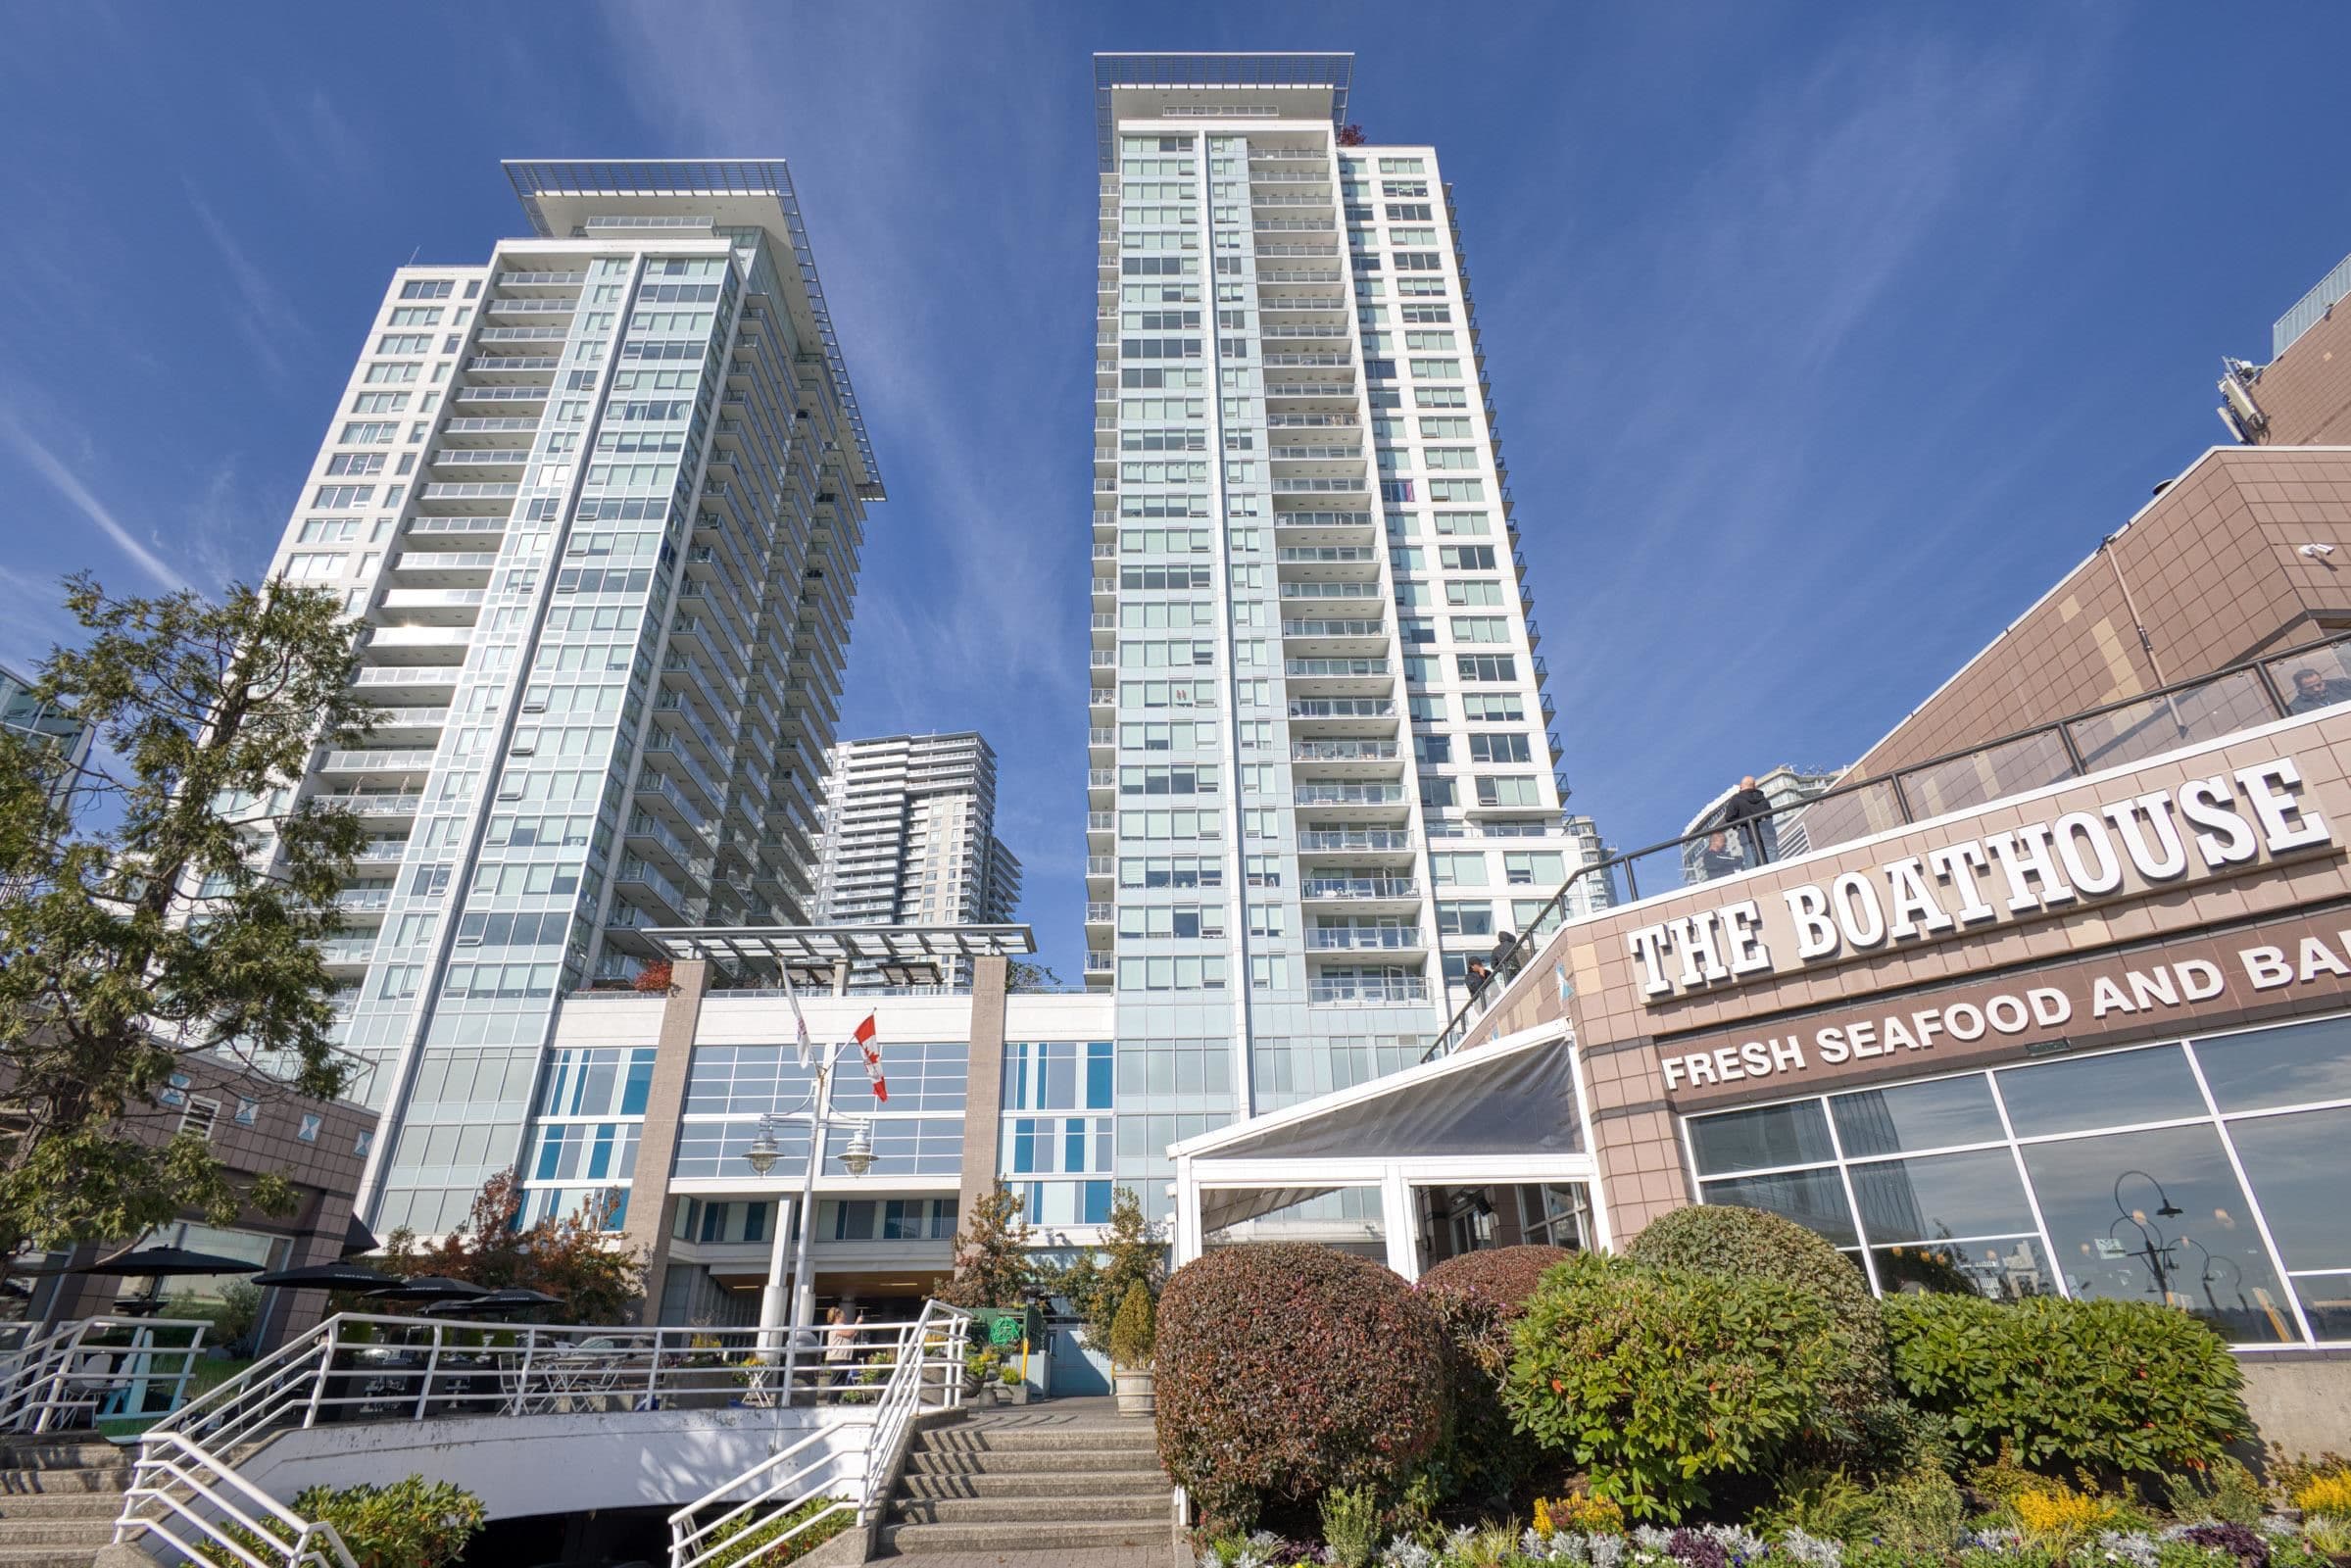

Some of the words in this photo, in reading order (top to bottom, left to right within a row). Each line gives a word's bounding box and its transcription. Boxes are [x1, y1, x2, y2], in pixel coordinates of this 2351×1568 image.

[1626, 900, 1771, 1004] THE
[1781, 757, 2332, 960] BOATHOUSE
[1661, 1035, 1806, 1091] FRESH
[1816, 987, 2072, 1064] SEAFOOD
[2093, 959, 2225, 1017] AND
[2237, 929, 2351, 990] BA
